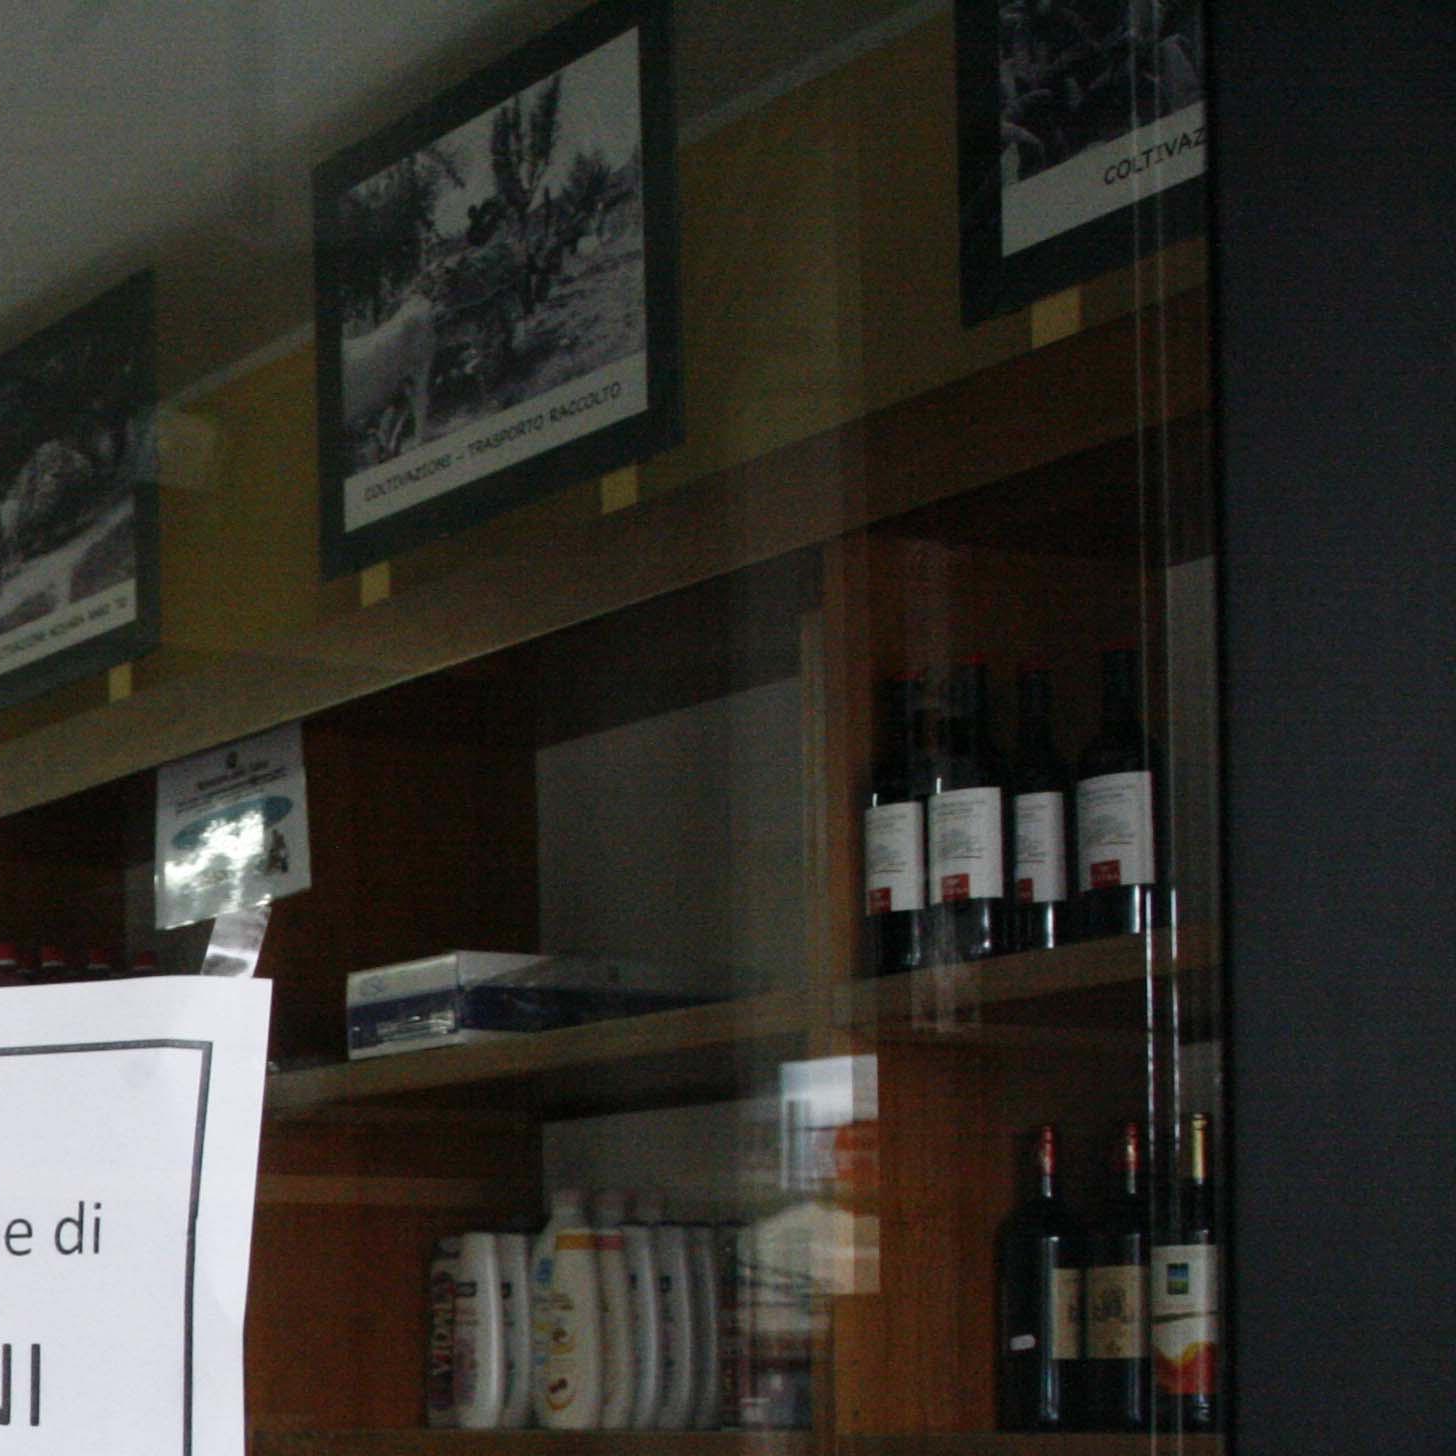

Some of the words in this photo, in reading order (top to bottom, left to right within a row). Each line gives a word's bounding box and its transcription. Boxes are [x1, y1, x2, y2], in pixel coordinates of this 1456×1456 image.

[468, 414, 544, 455] TRASPORTO
[550, 381, 622, 423] RACCOLTO
[54, 1201, 102, 1256] di
